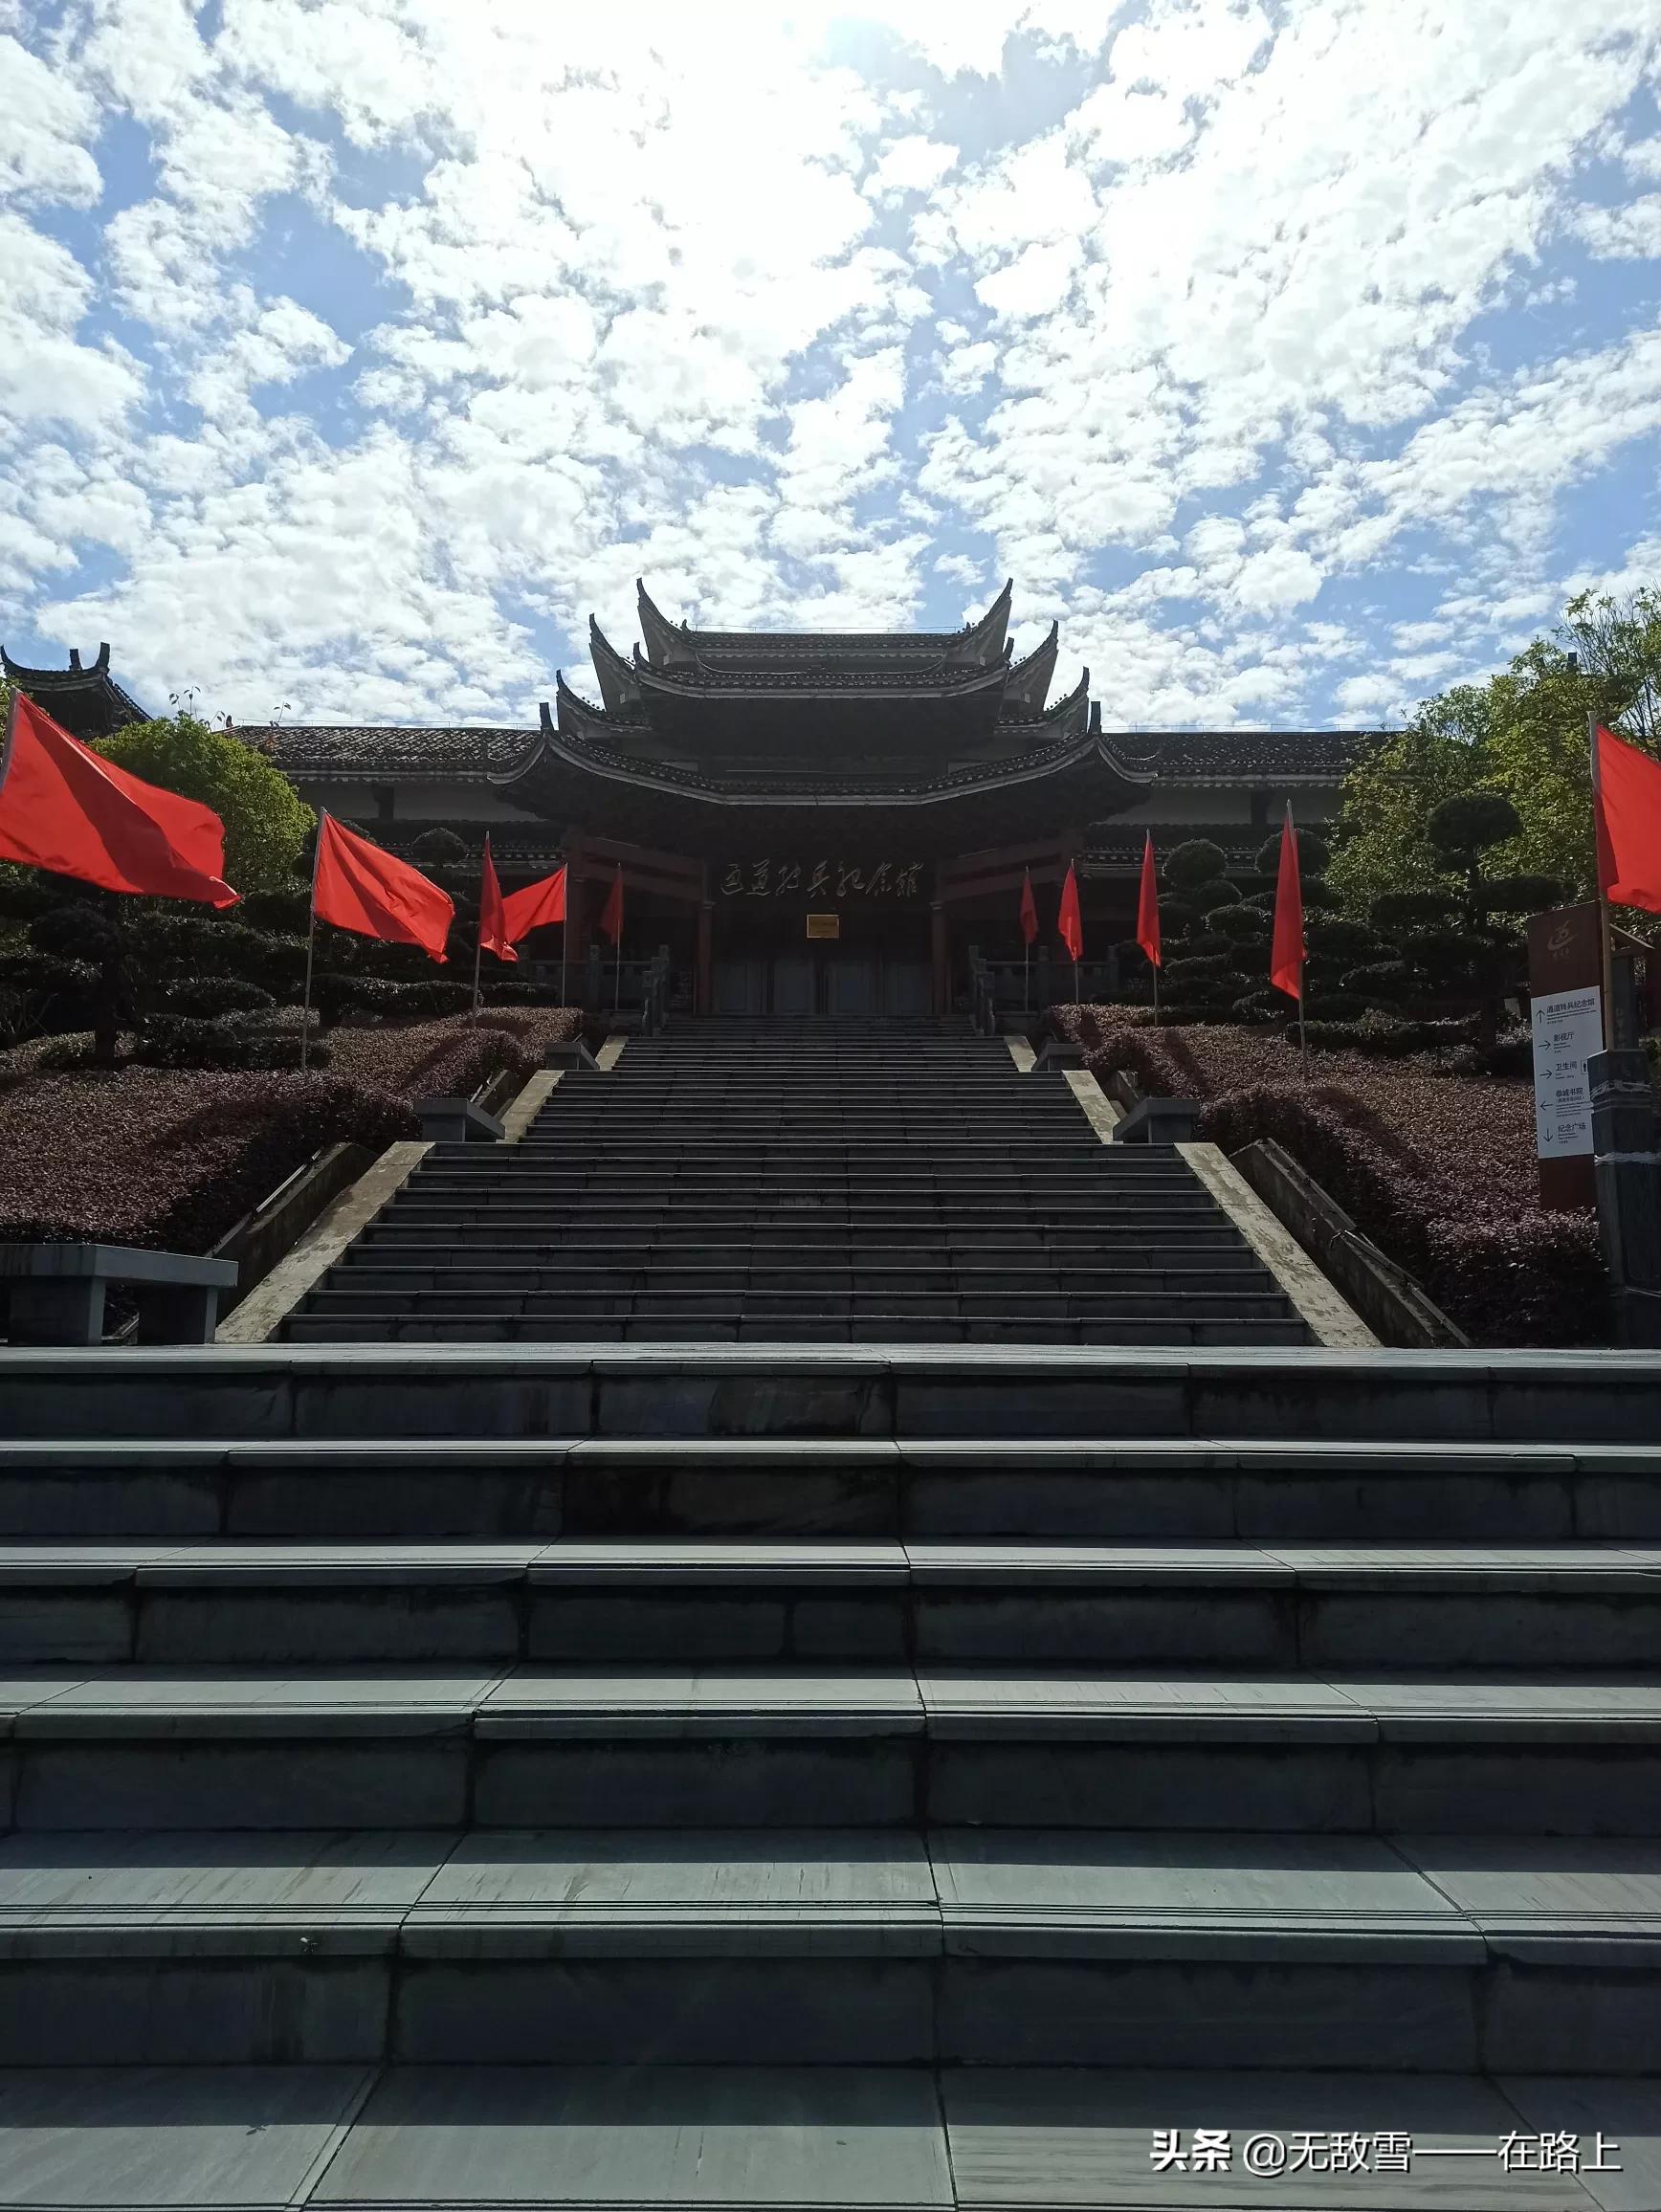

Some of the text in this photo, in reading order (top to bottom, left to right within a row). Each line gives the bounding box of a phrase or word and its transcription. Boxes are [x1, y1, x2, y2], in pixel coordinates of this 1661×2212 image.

[1546, 998, 1595, 1013] 通道转兵纪念馆
[1554, 1031, 1574, 1042] 影视厅
[1556, 1060, 1577, 1071] 卫生间
[1558, 1122, 1586, 1132] 纪念广场
